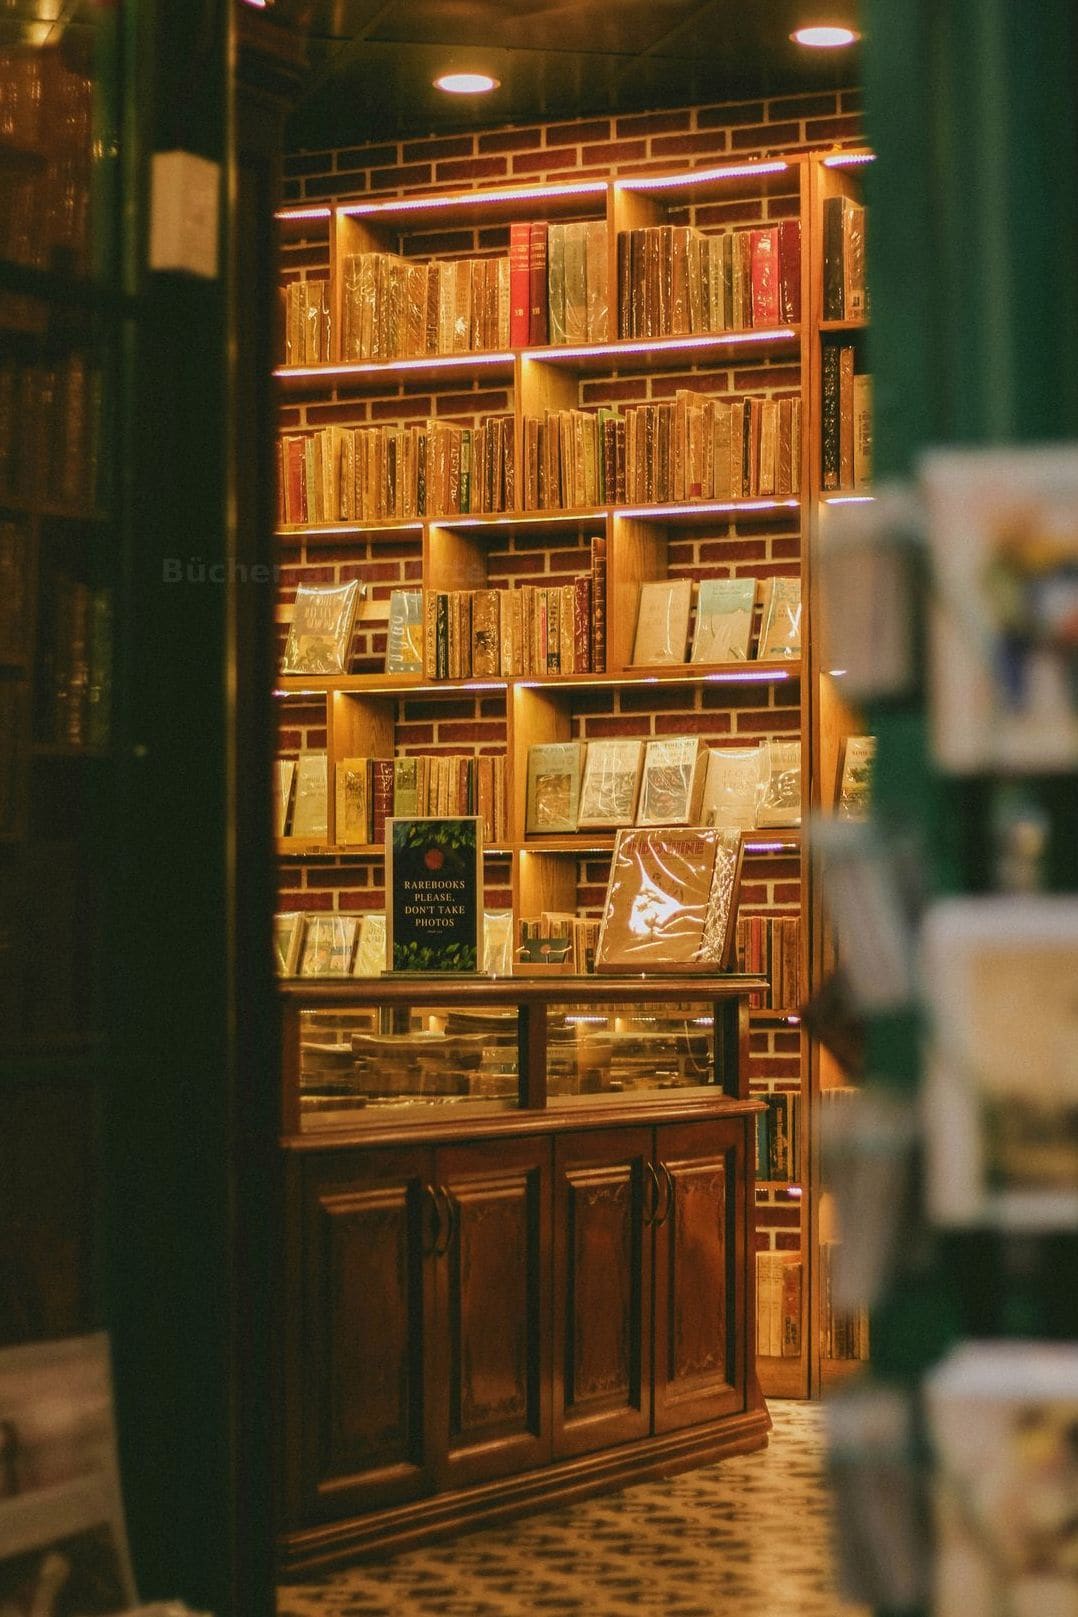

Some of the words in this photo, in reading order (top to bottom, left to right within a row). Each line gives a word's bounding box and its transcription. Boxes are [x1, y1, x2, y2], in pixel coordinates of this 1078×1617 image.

[404, 880, 465, 890] RAREBOOKS
[404, 906, 435, 915] DON'T
[437, 905, 465, 914] TAKE
[415, 918, 455, 928] PHOTOS
